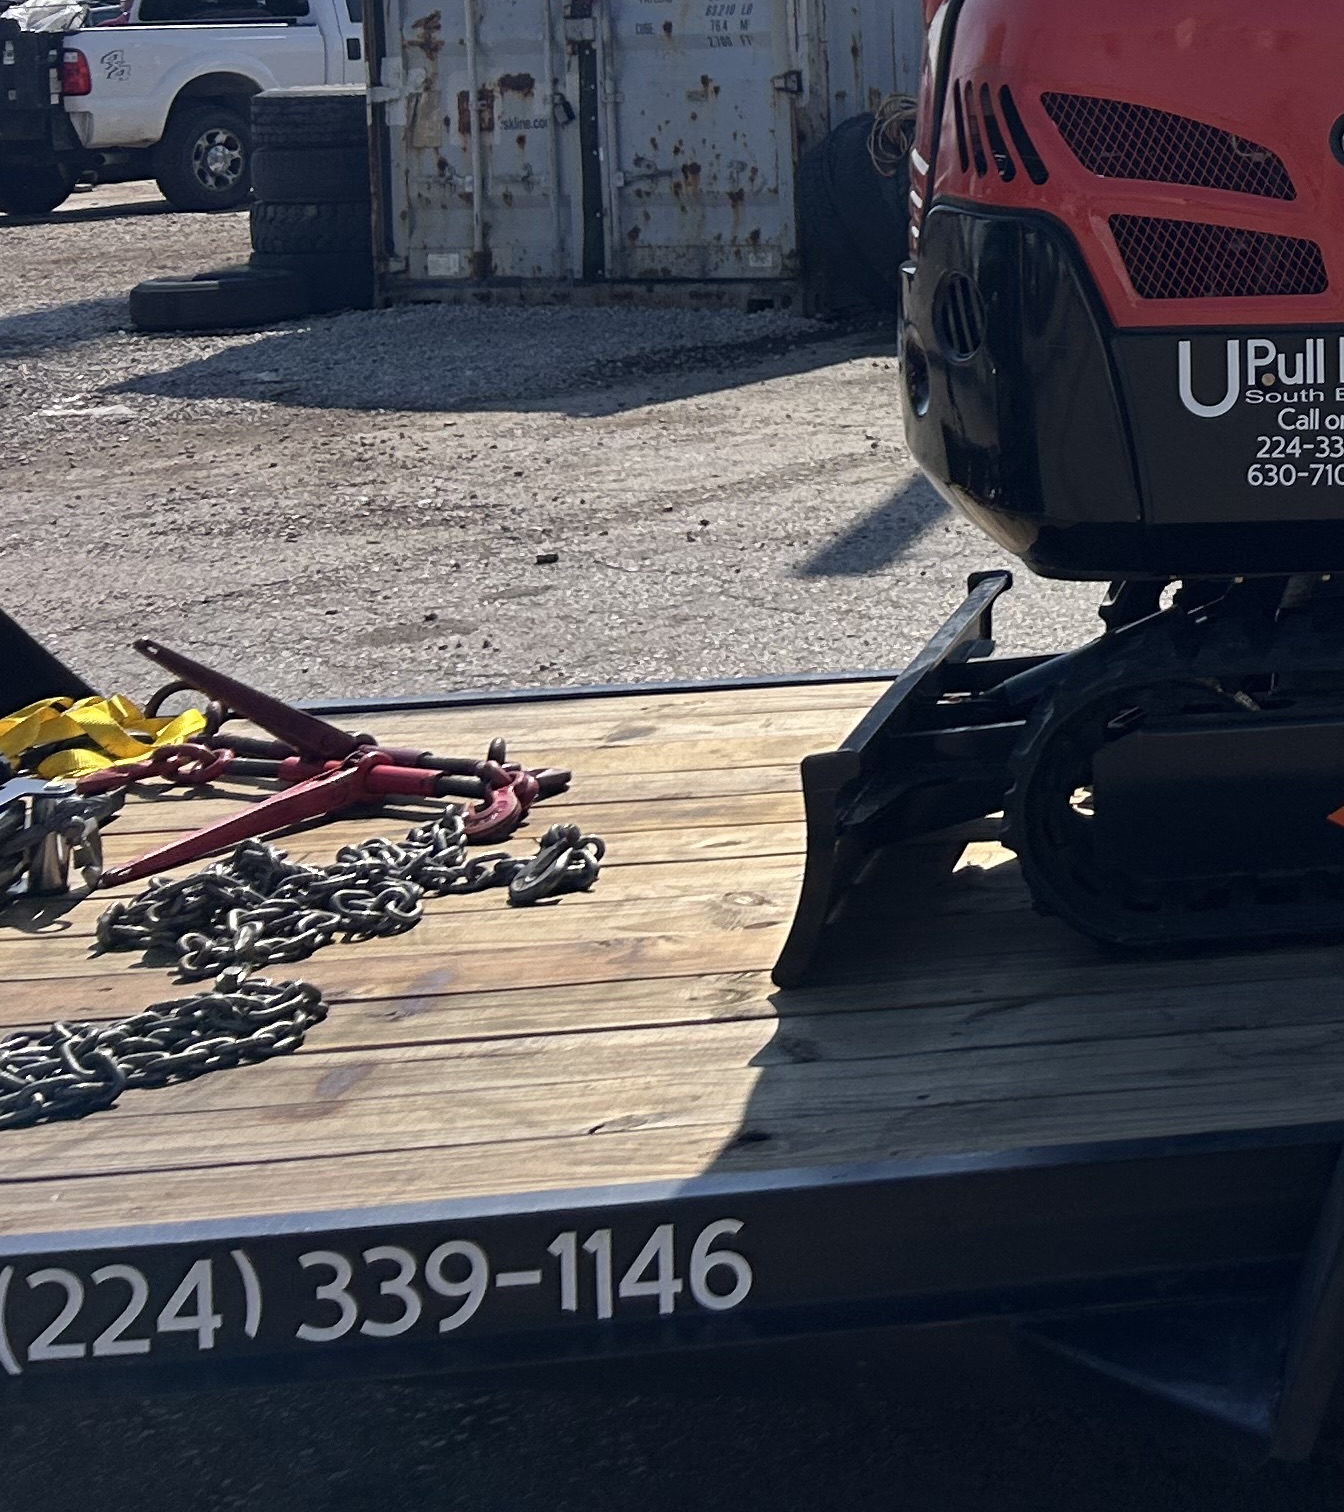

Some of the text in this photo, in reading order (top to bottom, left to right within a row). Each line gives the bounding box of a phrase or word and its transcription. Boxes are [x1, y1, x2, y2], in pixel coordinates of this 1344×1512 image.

[1245, 389, 1325, 404] South
[1277, 407, 1320, 431] Call
[0, 1218, 754, 1375] (224) 339-1146
